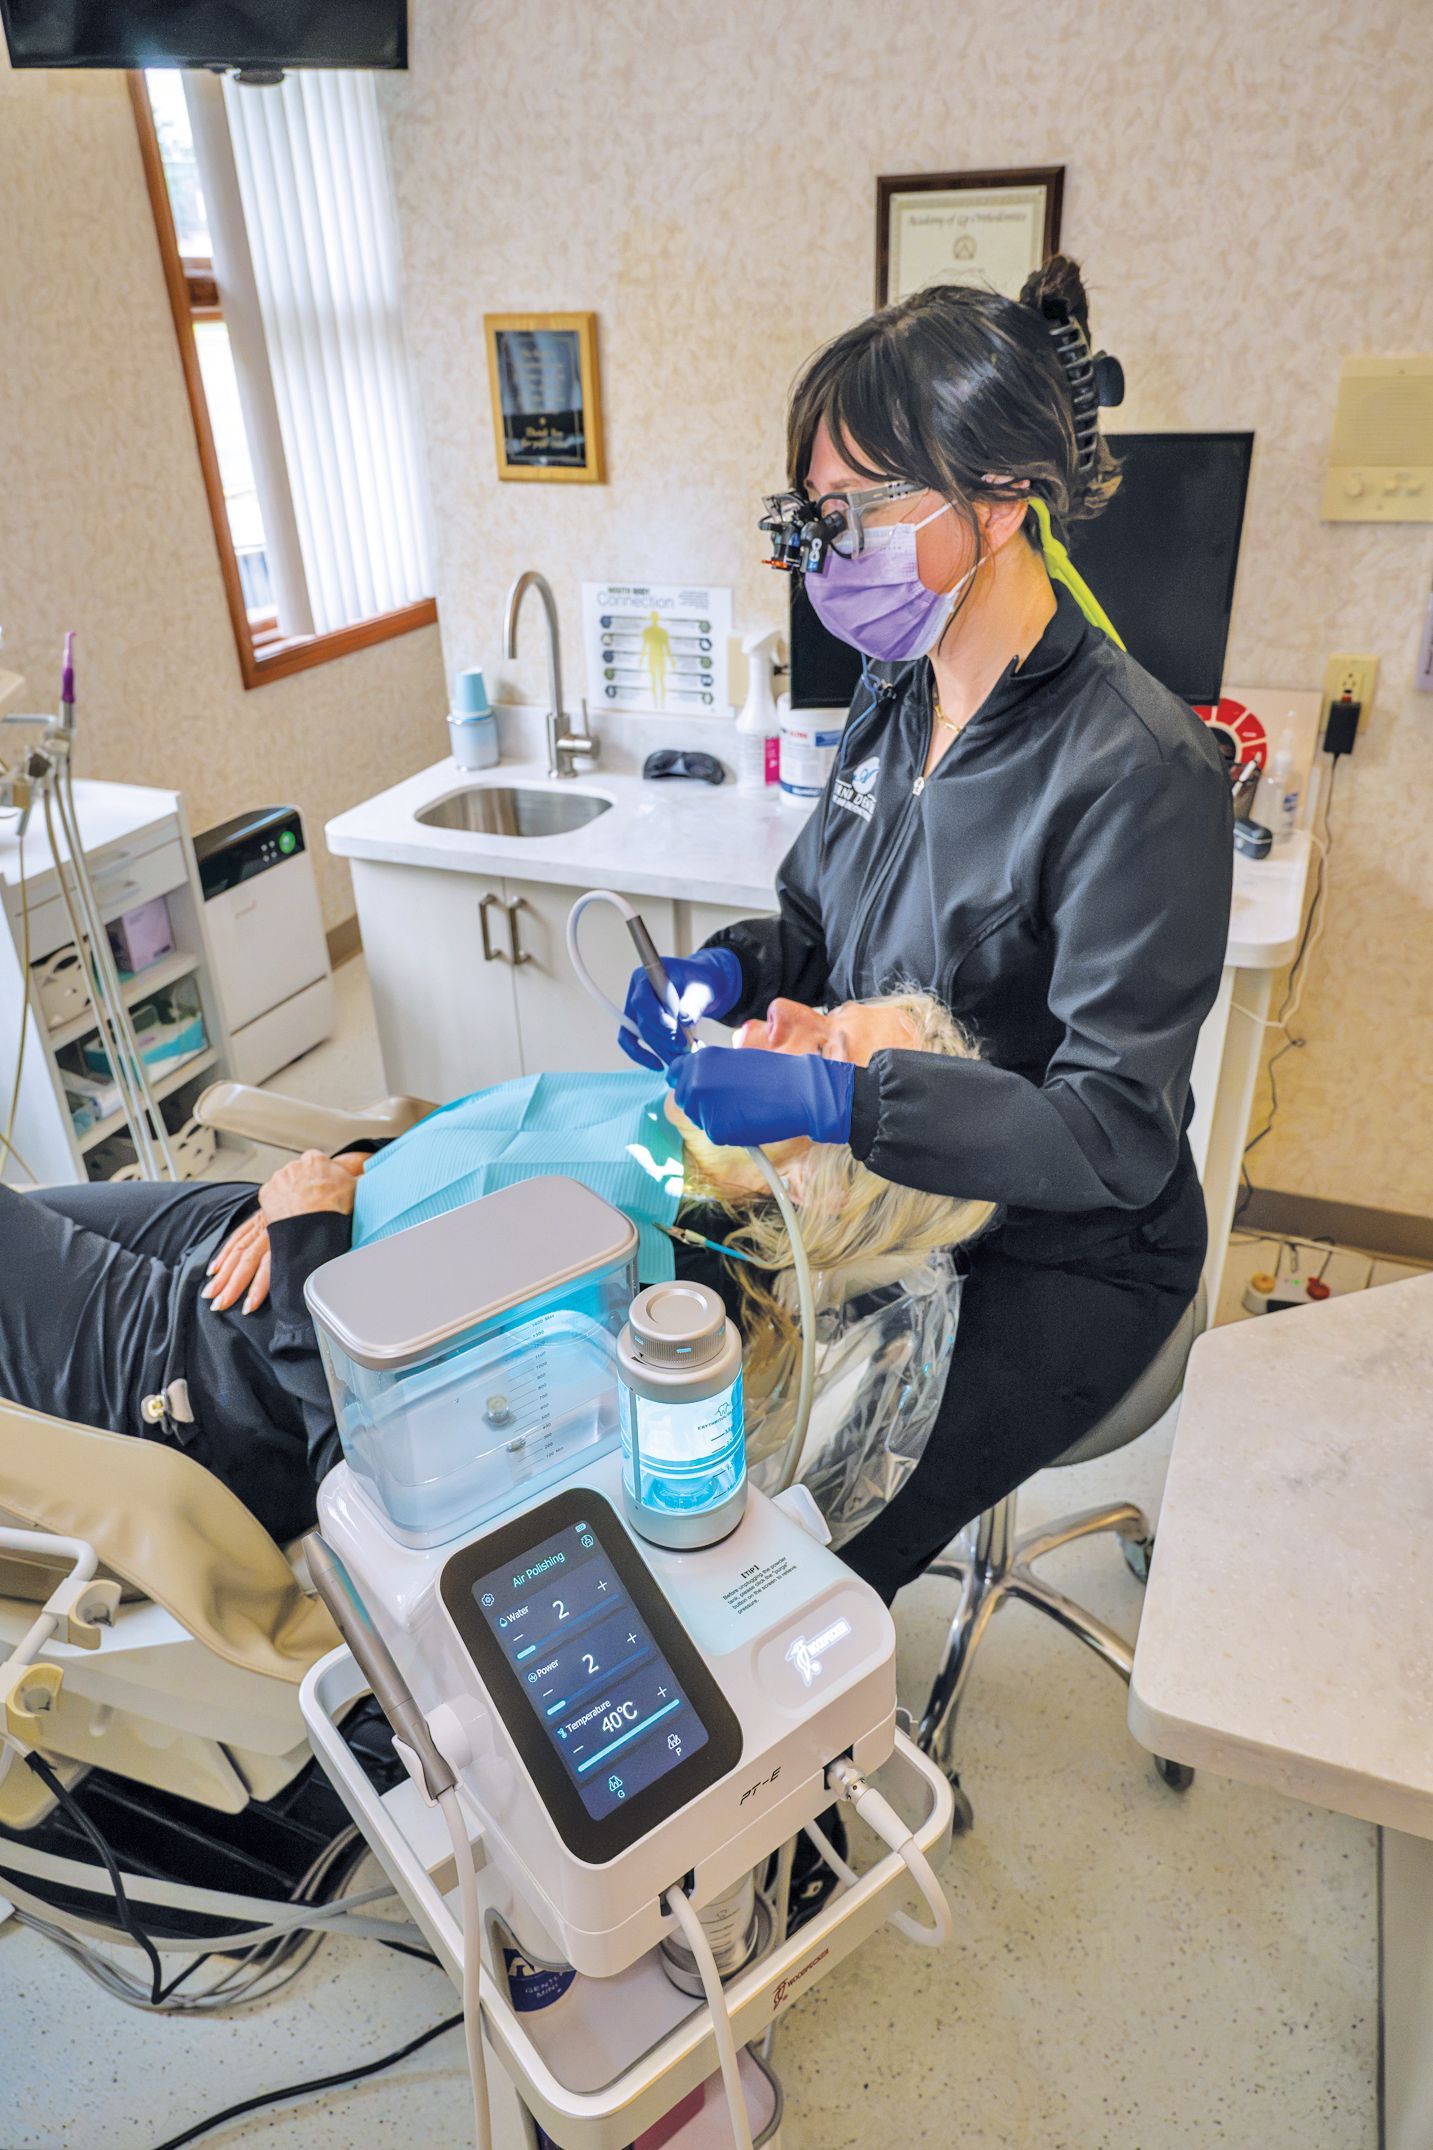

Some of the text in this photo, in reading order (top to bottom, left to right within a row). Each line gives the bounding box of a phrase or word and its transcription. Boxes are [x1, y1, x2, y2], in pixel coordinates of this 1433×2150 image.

[597, 591, 674, 608] Connection
[513, 1552, 566, 1588] Air Polishing
[723, 1588, 738, 1600] Before
[739, 1572, 764, 1590] unplugging
[770, 1556, 786, 1570] powder
[732, 1598, 747, 1609] button
[762, 1578, 777, 1590] screen
[782, 1566, 797, 1576] relieve
[740, 1586, 754, 1597] please
[506, 1606, 529, 1622] Water
[552, 1600, 570, 1620] 2
[738, 1599, 759, 1614] pressure.
[536, 1659, 559, 1678] Power
[582, 1654, 599, 1674] 2
[565, 1700, 611, 1734] Temperature
[675, 1747, 682, 1756] P
[617, 1790, 625, 1798] G
[740, 1766, 781, 1806] PT-E
